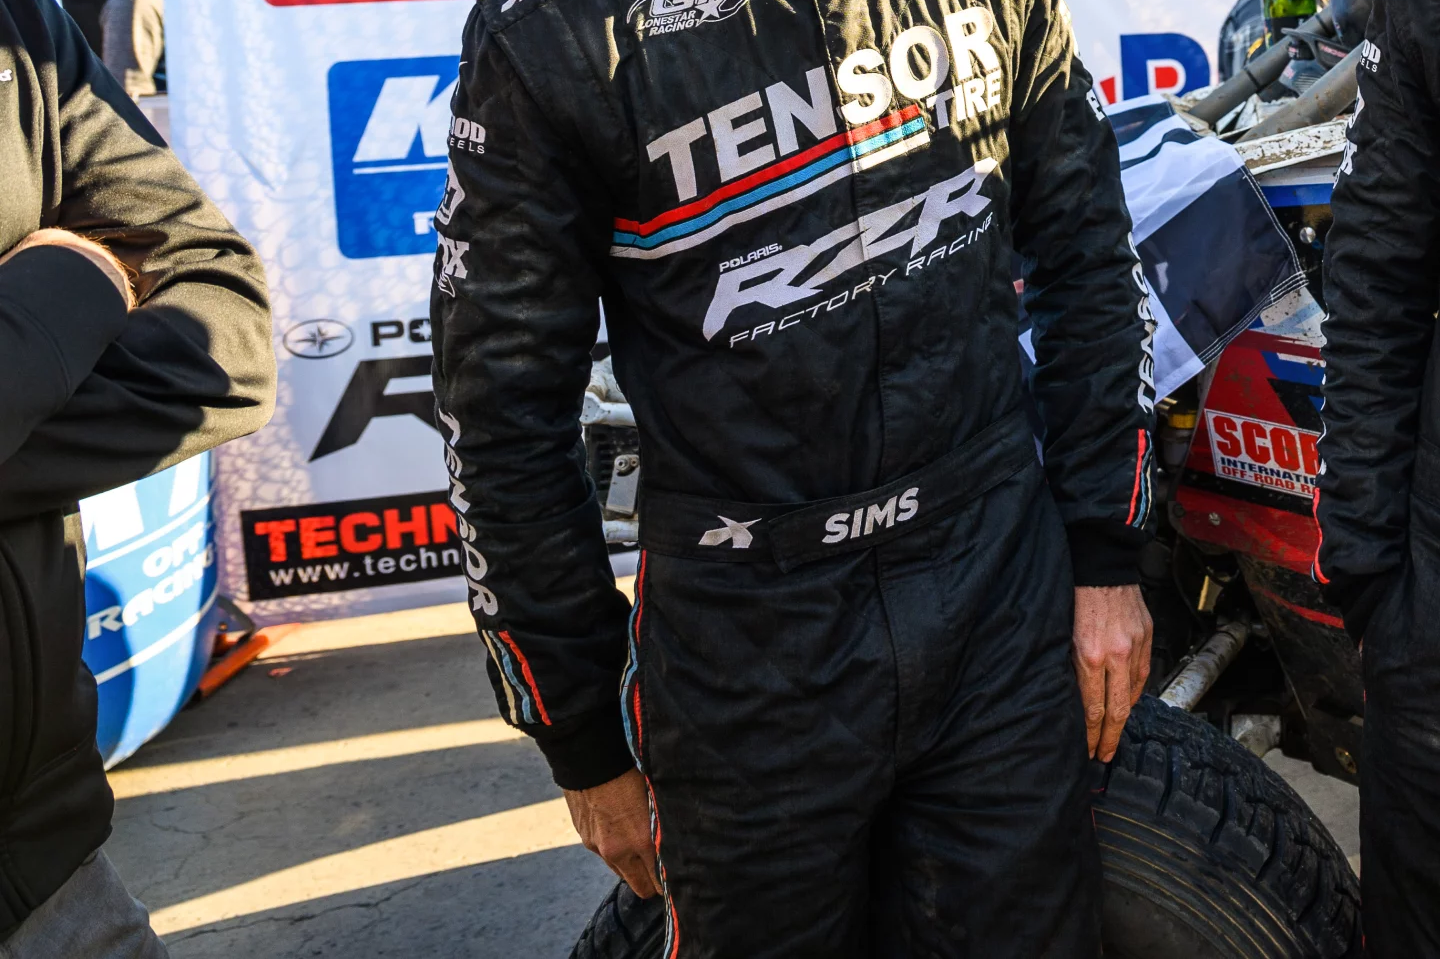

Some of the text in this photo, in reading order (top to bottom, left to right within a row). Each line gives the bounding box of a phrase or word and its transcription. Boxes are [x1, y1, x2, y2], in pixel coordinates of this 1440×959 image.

[637, 10, 697, 30] LONESTAR
[649, 21, 695, 37] RACING
[645, 6, 1001, 203] TENSOR
[926, 77, 1002, 130] TIRE
[702, 156, 999, 343] RZR
[719, 243, 780, 272] POLARIS
[729, 211, 995, 348] FACTORY RACING
[1221, 466, 1296, 490] OFF-ROAD
[822, 487, 920, 544] SIMS
